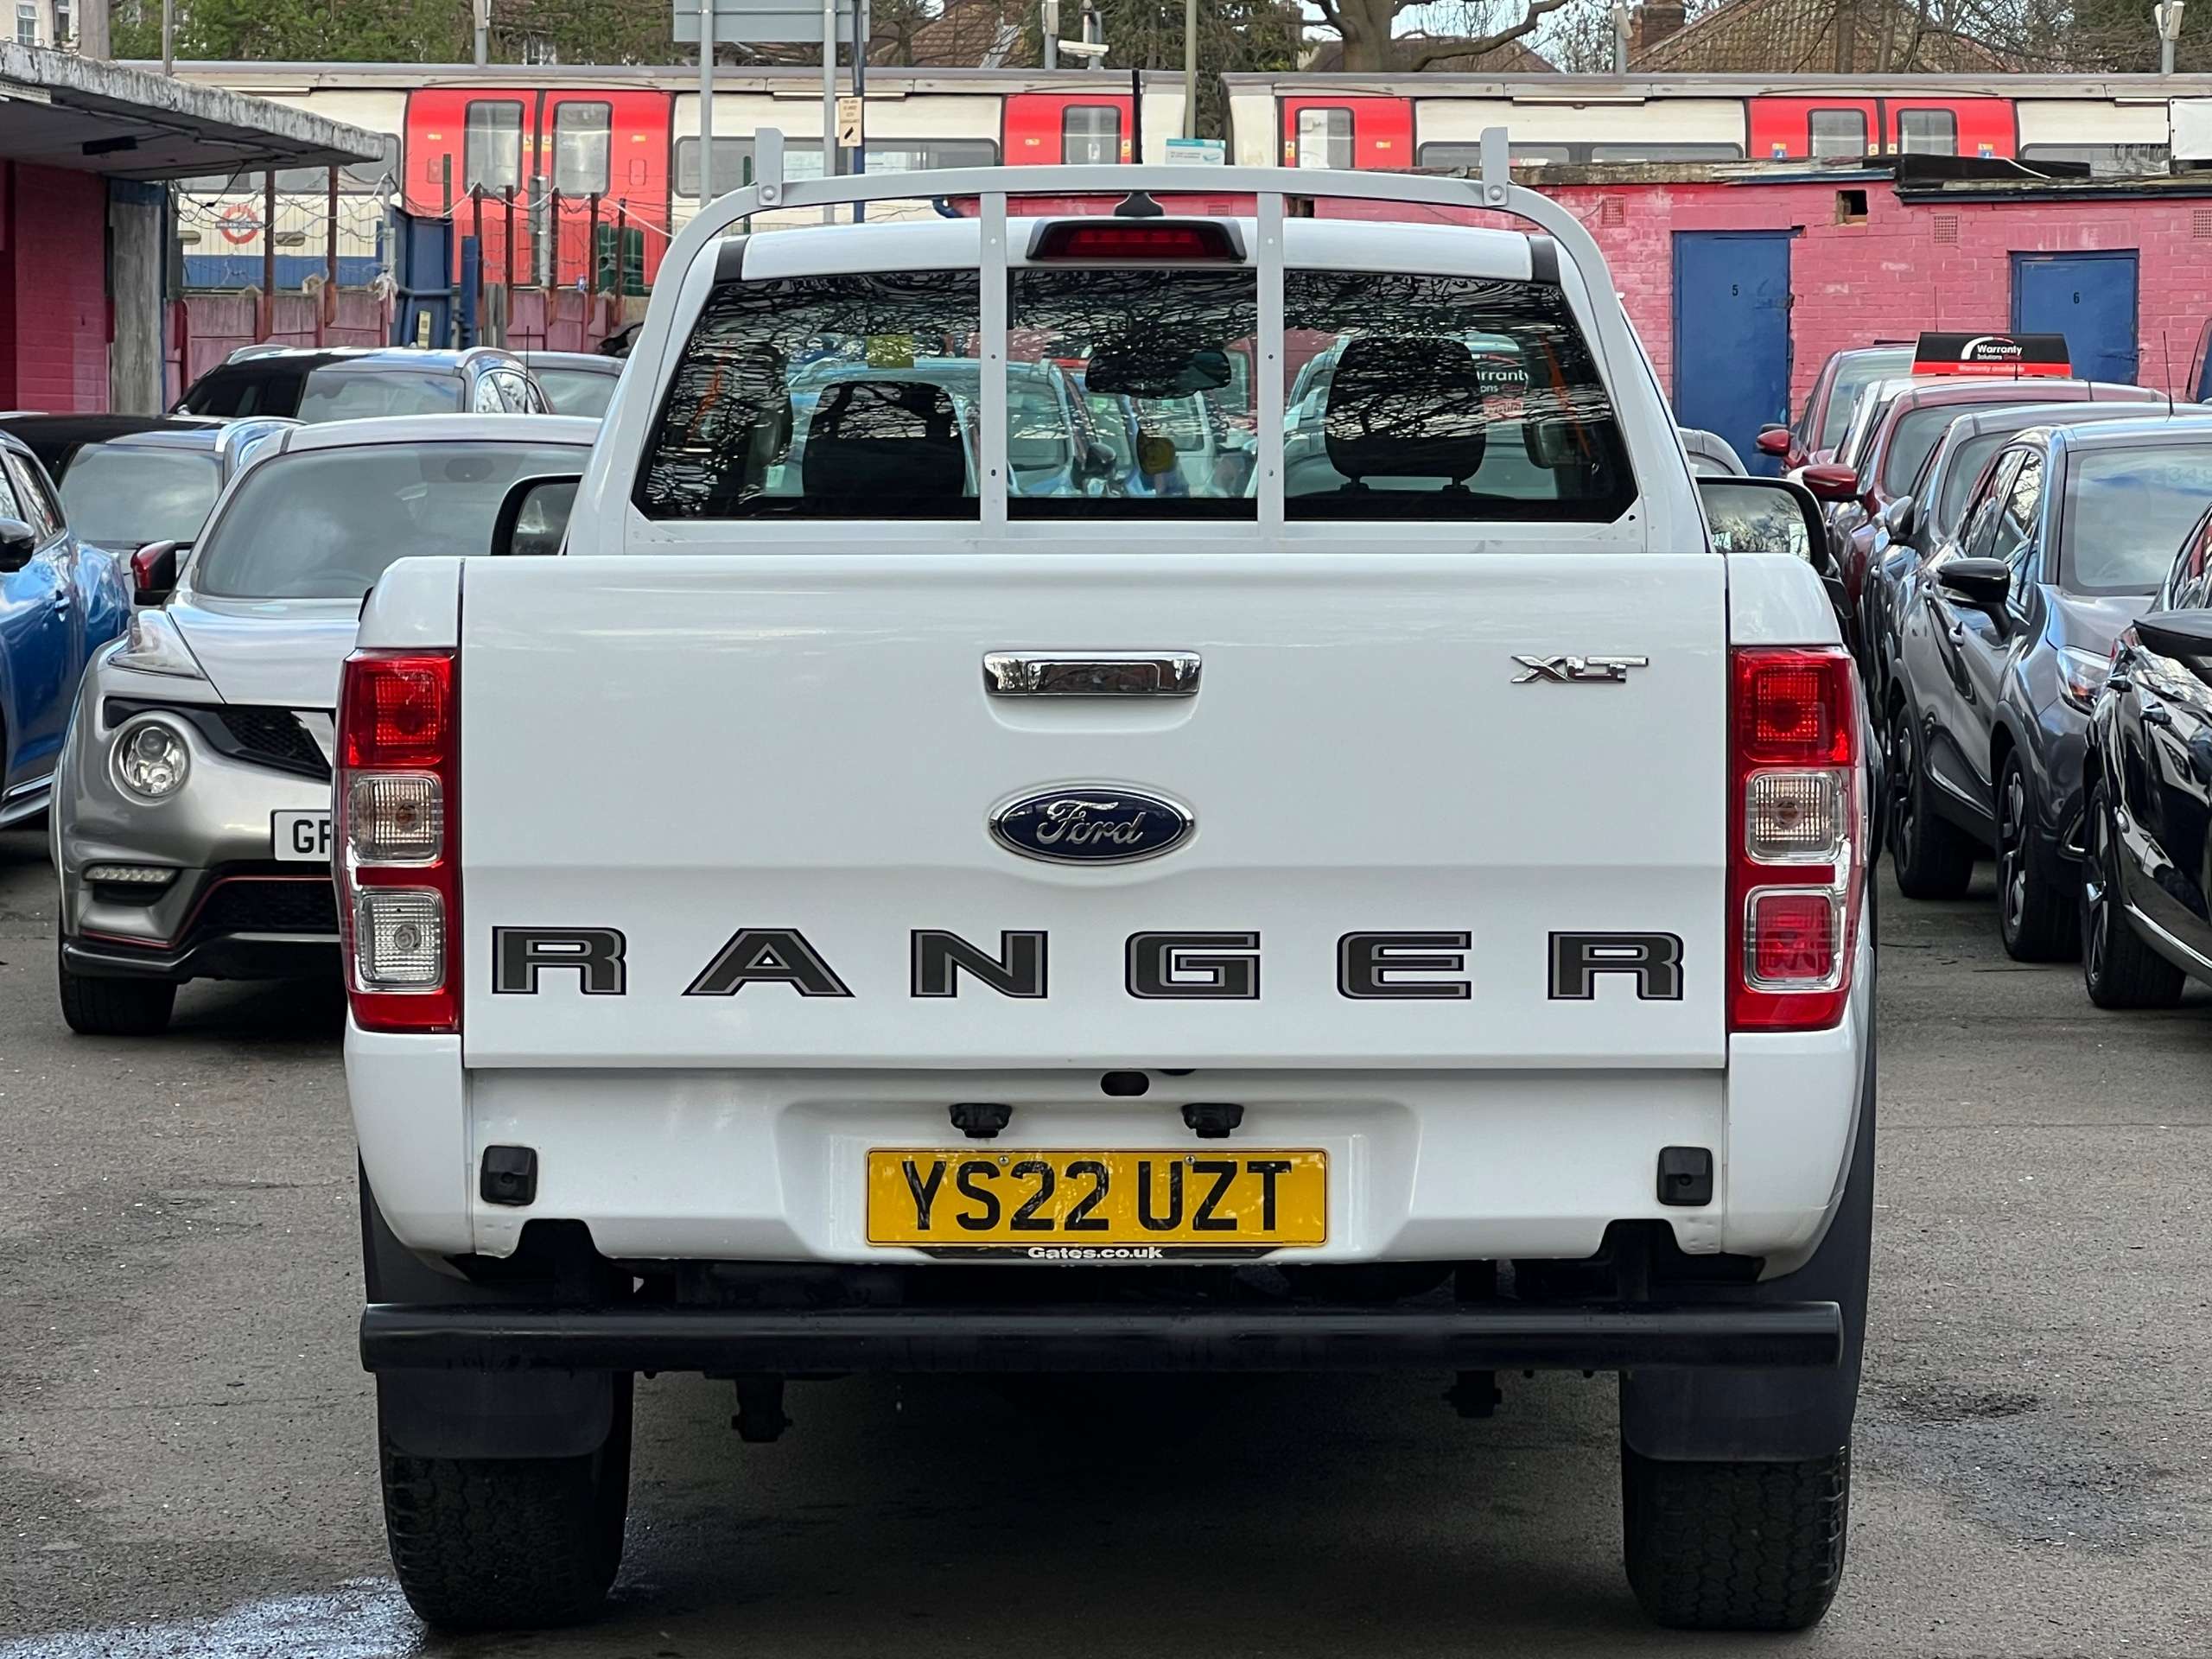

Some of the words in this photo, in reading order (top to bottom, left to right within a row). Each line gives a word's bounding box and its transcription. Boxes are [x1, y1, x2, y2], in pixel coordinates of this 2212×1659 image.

[1732, 284, 1738, 296] 5
[2073, 292, 2080, 304] 6
[1977, 345, 2023, 357] Warranty
[1511, 655, 1649, 683] XLT
[1037, 799, 1147, 844] Ford
[492, 925, 1684, 1001] RANGER
[902, 1160, 1109, 1230] YS22
[1138, 1160, 1292, 1230] UZT
[1027, 1247, 1163, 1259] Gates.co.uk
